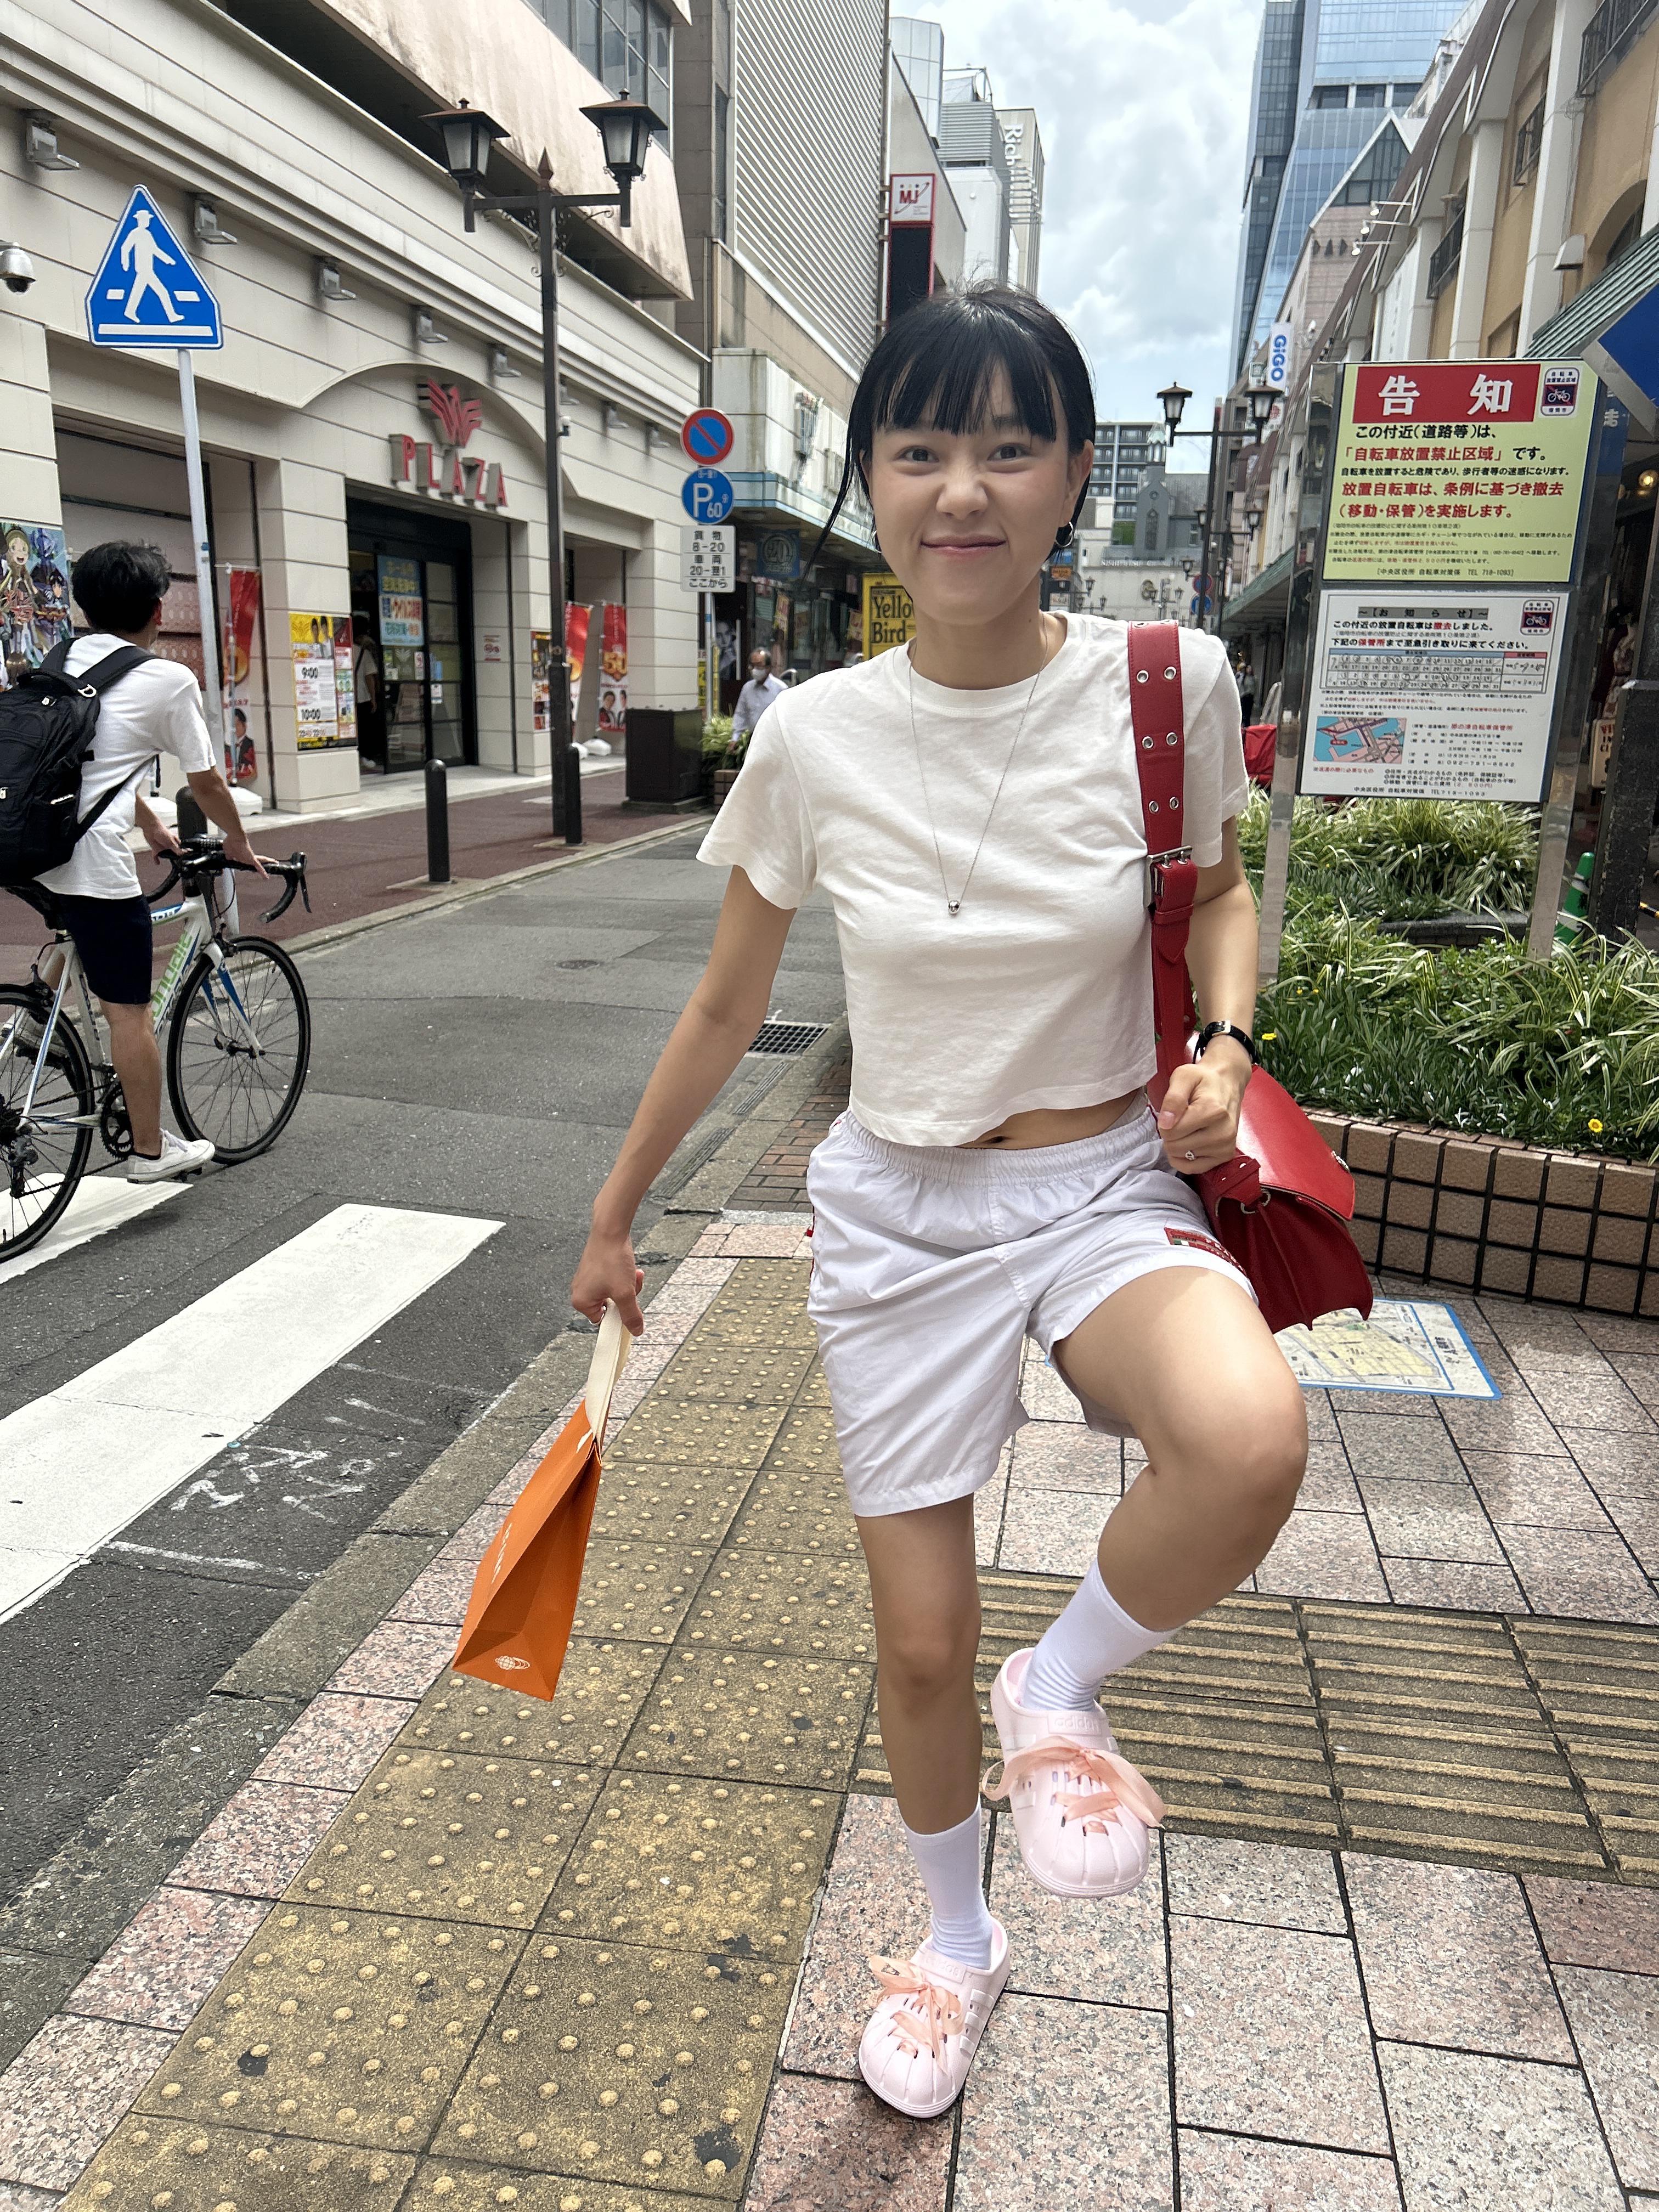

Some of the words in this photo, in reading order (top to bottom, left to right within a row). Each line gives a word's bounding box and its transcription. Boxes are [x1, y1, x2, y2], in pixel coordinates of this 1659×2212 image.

[1271, 335, 1286, 381] GiGO
[1378, 374, 1513, 416] 告知
[1356, 425, 1496, 439] この付近（道路等）は、
[1346, 446, 1501, 461] 「自転車放置禁止区域」
[1513, 447, 1545, 460] です。
[391, 434, 508, 507] PLAZA
[1342, 482, 1564, 496] 放置自転車は、条例に基づき撤去
[693, 483, 714, 518] P
[1340, 504, 1511, 518] （移動・保管）を実施します。
[692, 542, 725, 552] 8-20
[689, 578, 728, 588] ここから
[872, 595, 912, 619] Yello
[872, 620, 906, 643] Bird
[1333, 620, 1493, 631] この付近の放置自転車は撤去しました。
[1331, 637, 1528, 650] 下記の保管所まで至急引き取りに来てください。
